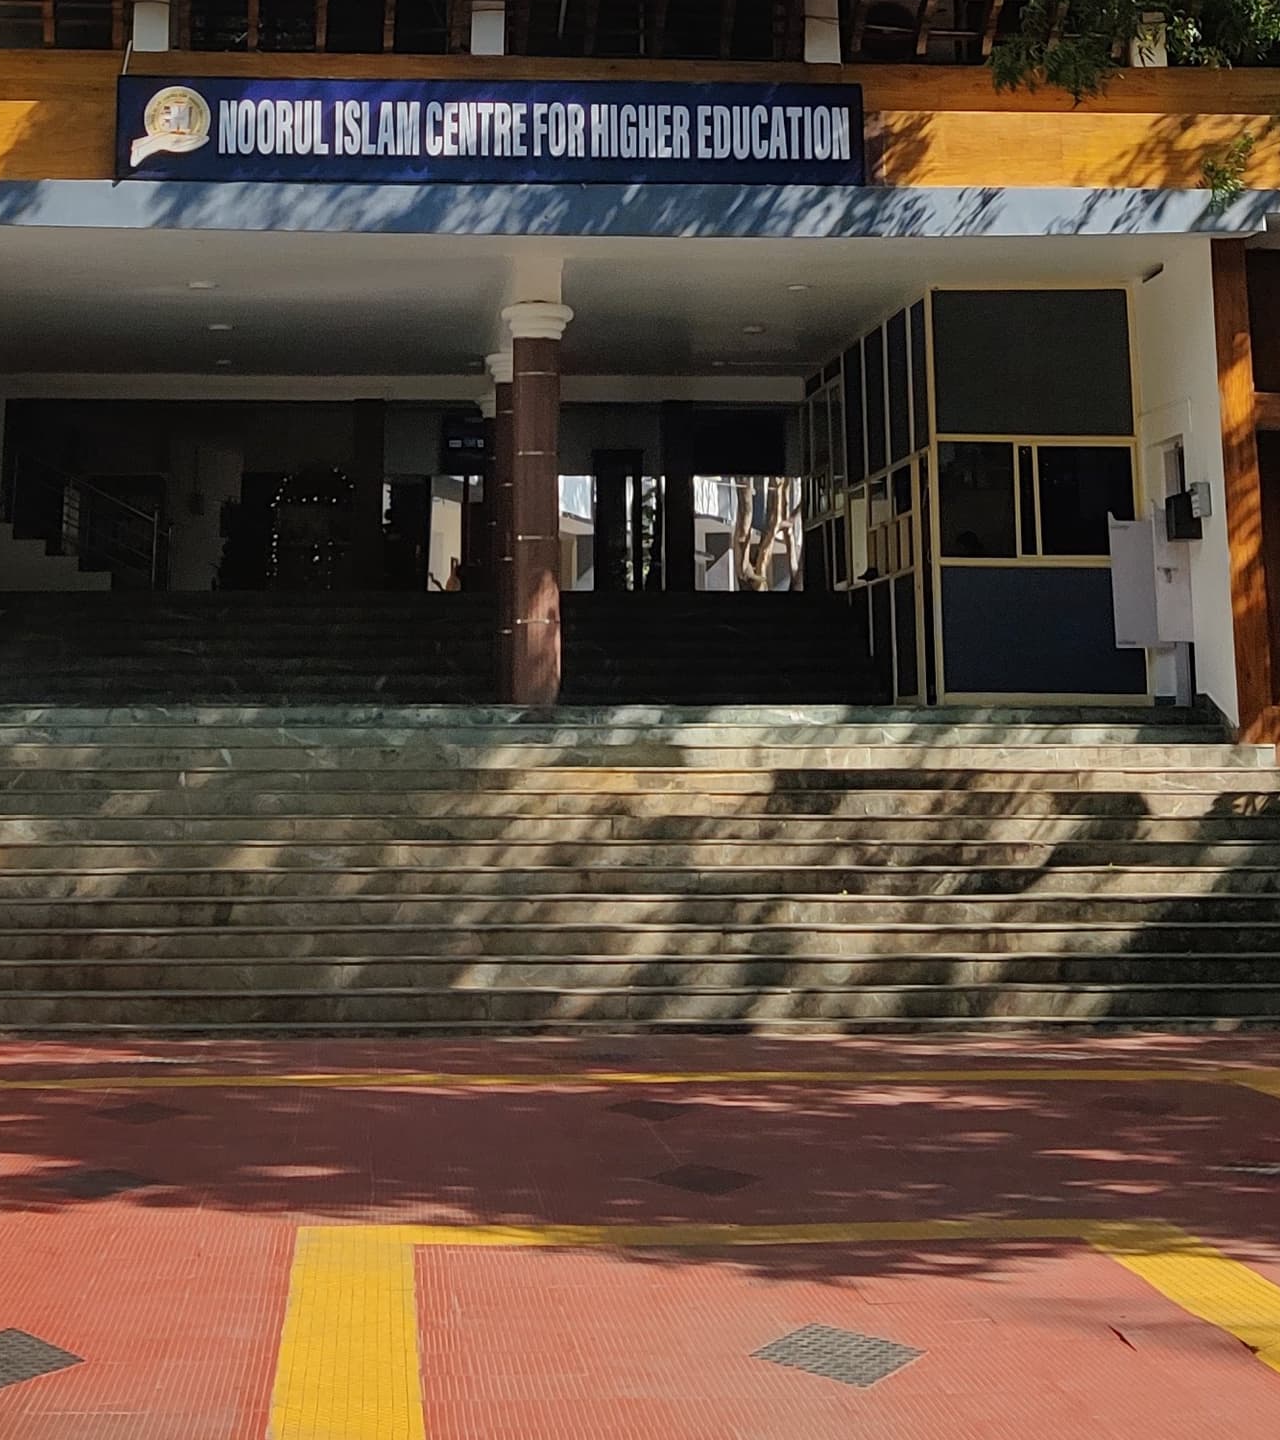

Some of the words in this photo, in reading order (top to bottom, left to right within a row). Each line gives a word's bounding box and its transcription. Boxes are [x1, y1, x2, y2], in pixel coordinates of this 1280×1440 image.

[218, 99, 328, 155] NOORUL
[335, 100, 420, 156] ISLAM
[425, 101, 527, 157] CENTRE
[533, 102, 585, 157] FOR
[591, 103, 690, 159] HIGHER
[697, 105, 851, 160] EDUCATION
